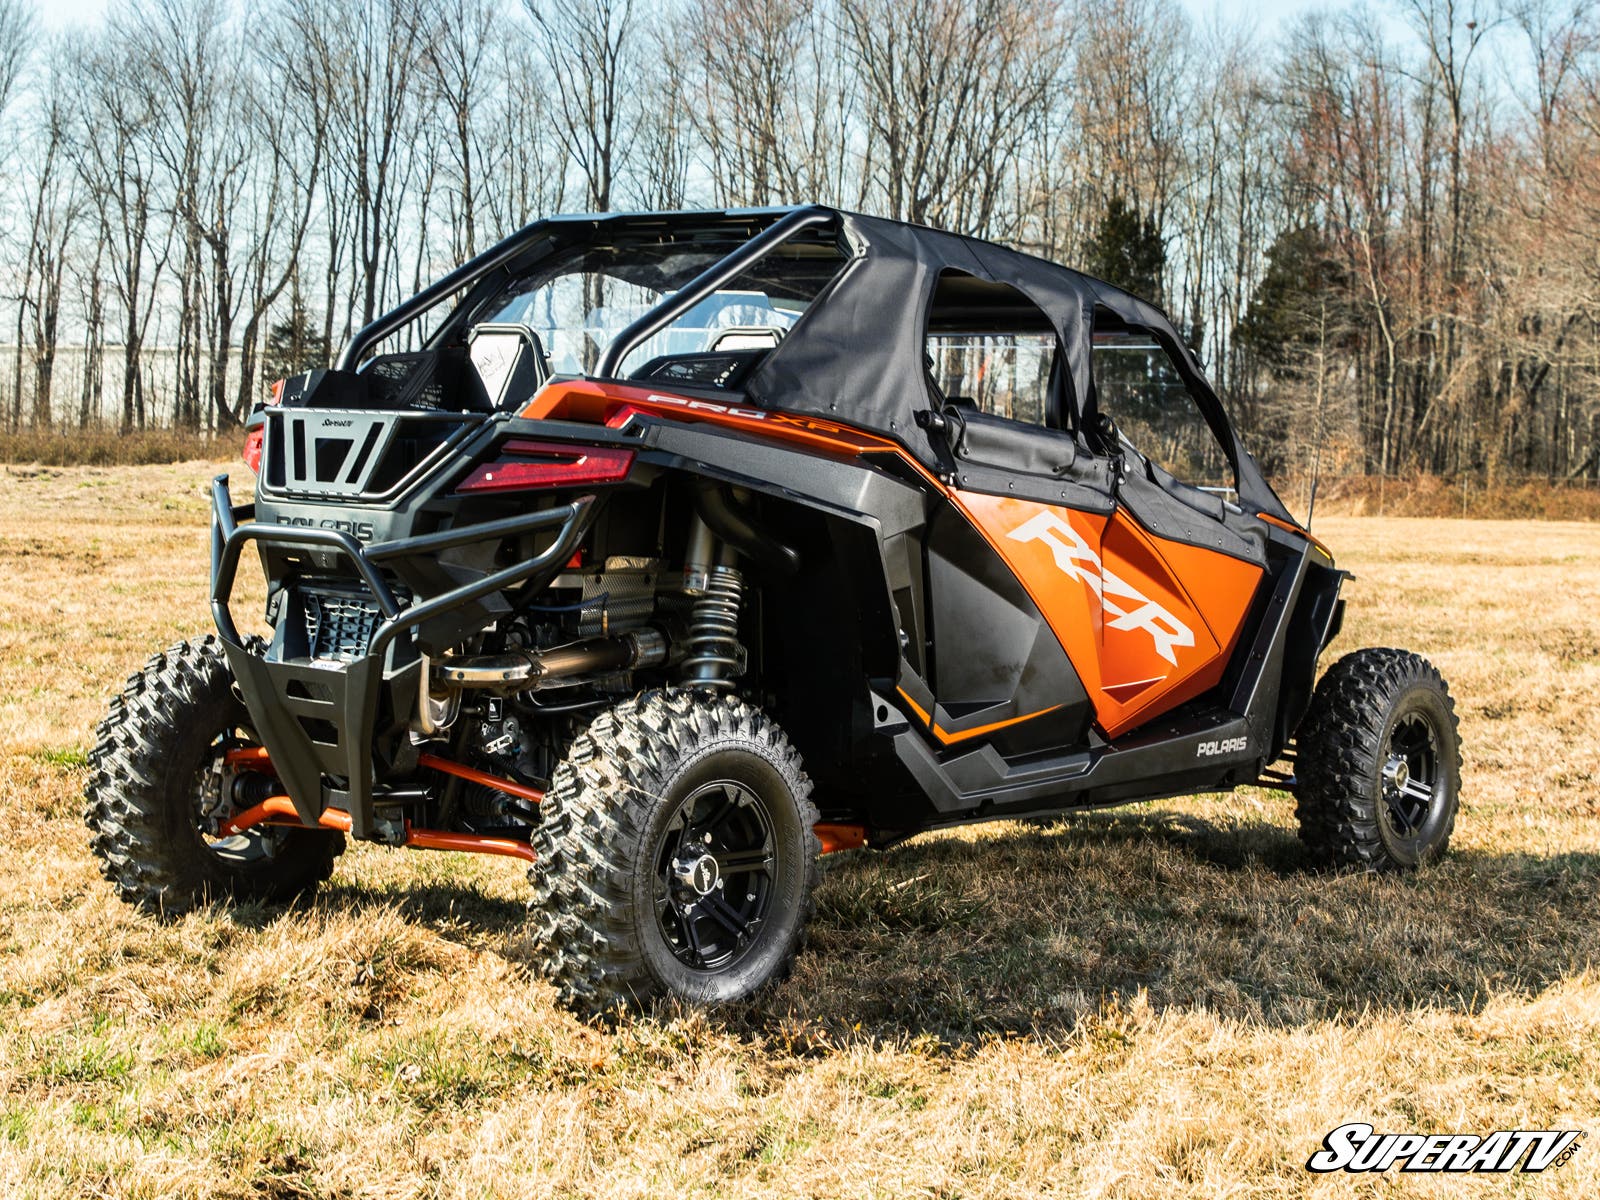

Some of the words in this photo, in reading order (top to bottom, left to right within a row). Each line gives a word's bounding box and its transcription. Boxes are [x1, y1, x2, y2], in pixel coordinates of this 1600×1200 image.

[648, 394, 767, 420] PRO
[1005, 509, 1196, 668] RZR
[1196, 736, 1248, 757] POLARIS
